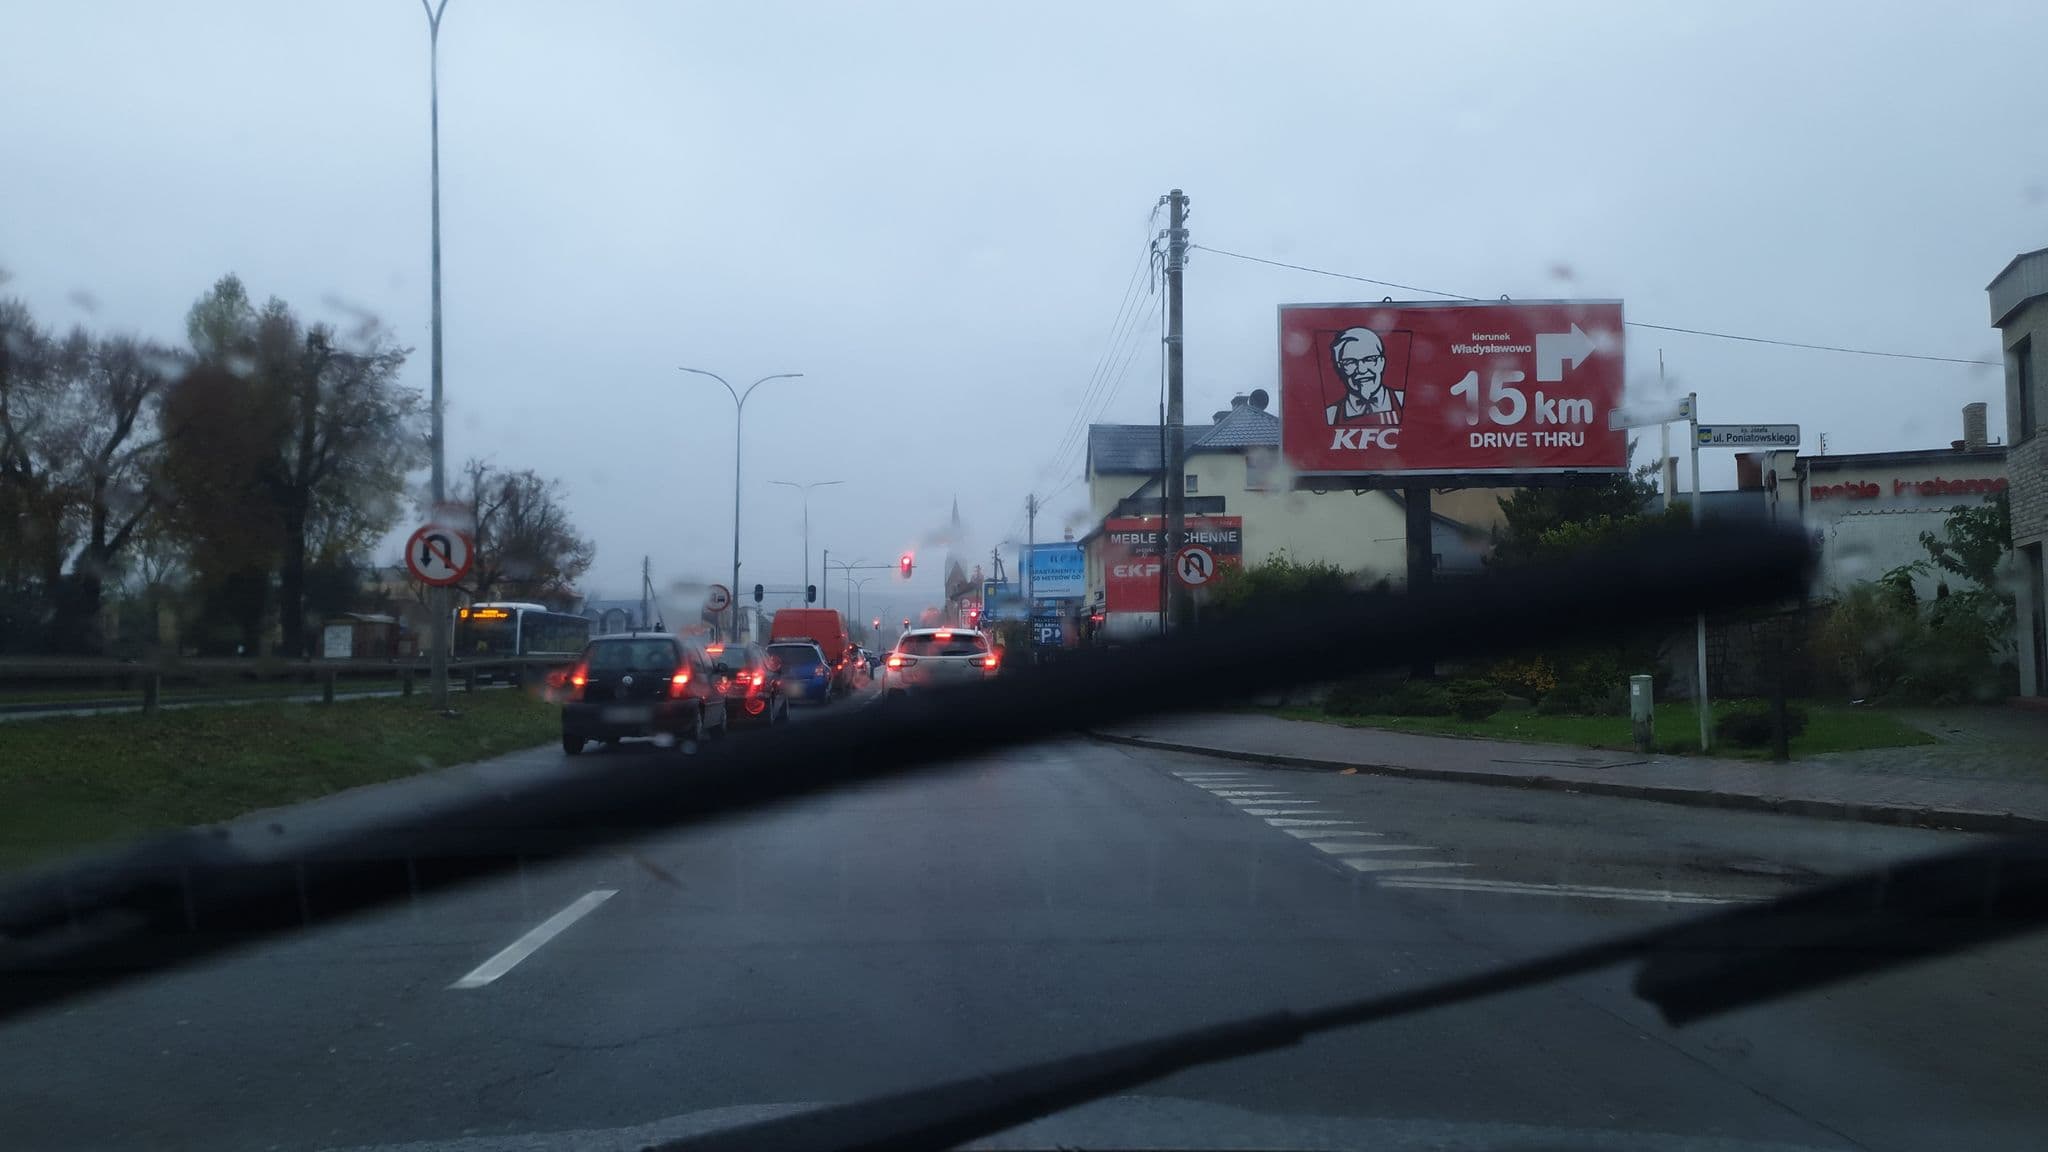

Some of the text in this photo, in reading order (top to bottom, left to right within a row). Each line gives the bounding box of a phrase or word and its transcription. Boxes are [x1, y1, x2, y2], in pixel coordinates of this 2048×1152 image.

[1472, 332, 1511, 341] kierunek
[1451, 343, 1532, 356] Władysławowo
[1449, 369, 1594, 426] 15 km
[1330, 428, 1401, 451] KFC
[1470, 431, 1585, 449] DRIVE THRU
[1713, 432, 1796, 445] ul. Poniatowskiego
[1111, 533, 1157, 545] MEBLE
[1041, 627, 1052, 644] P
